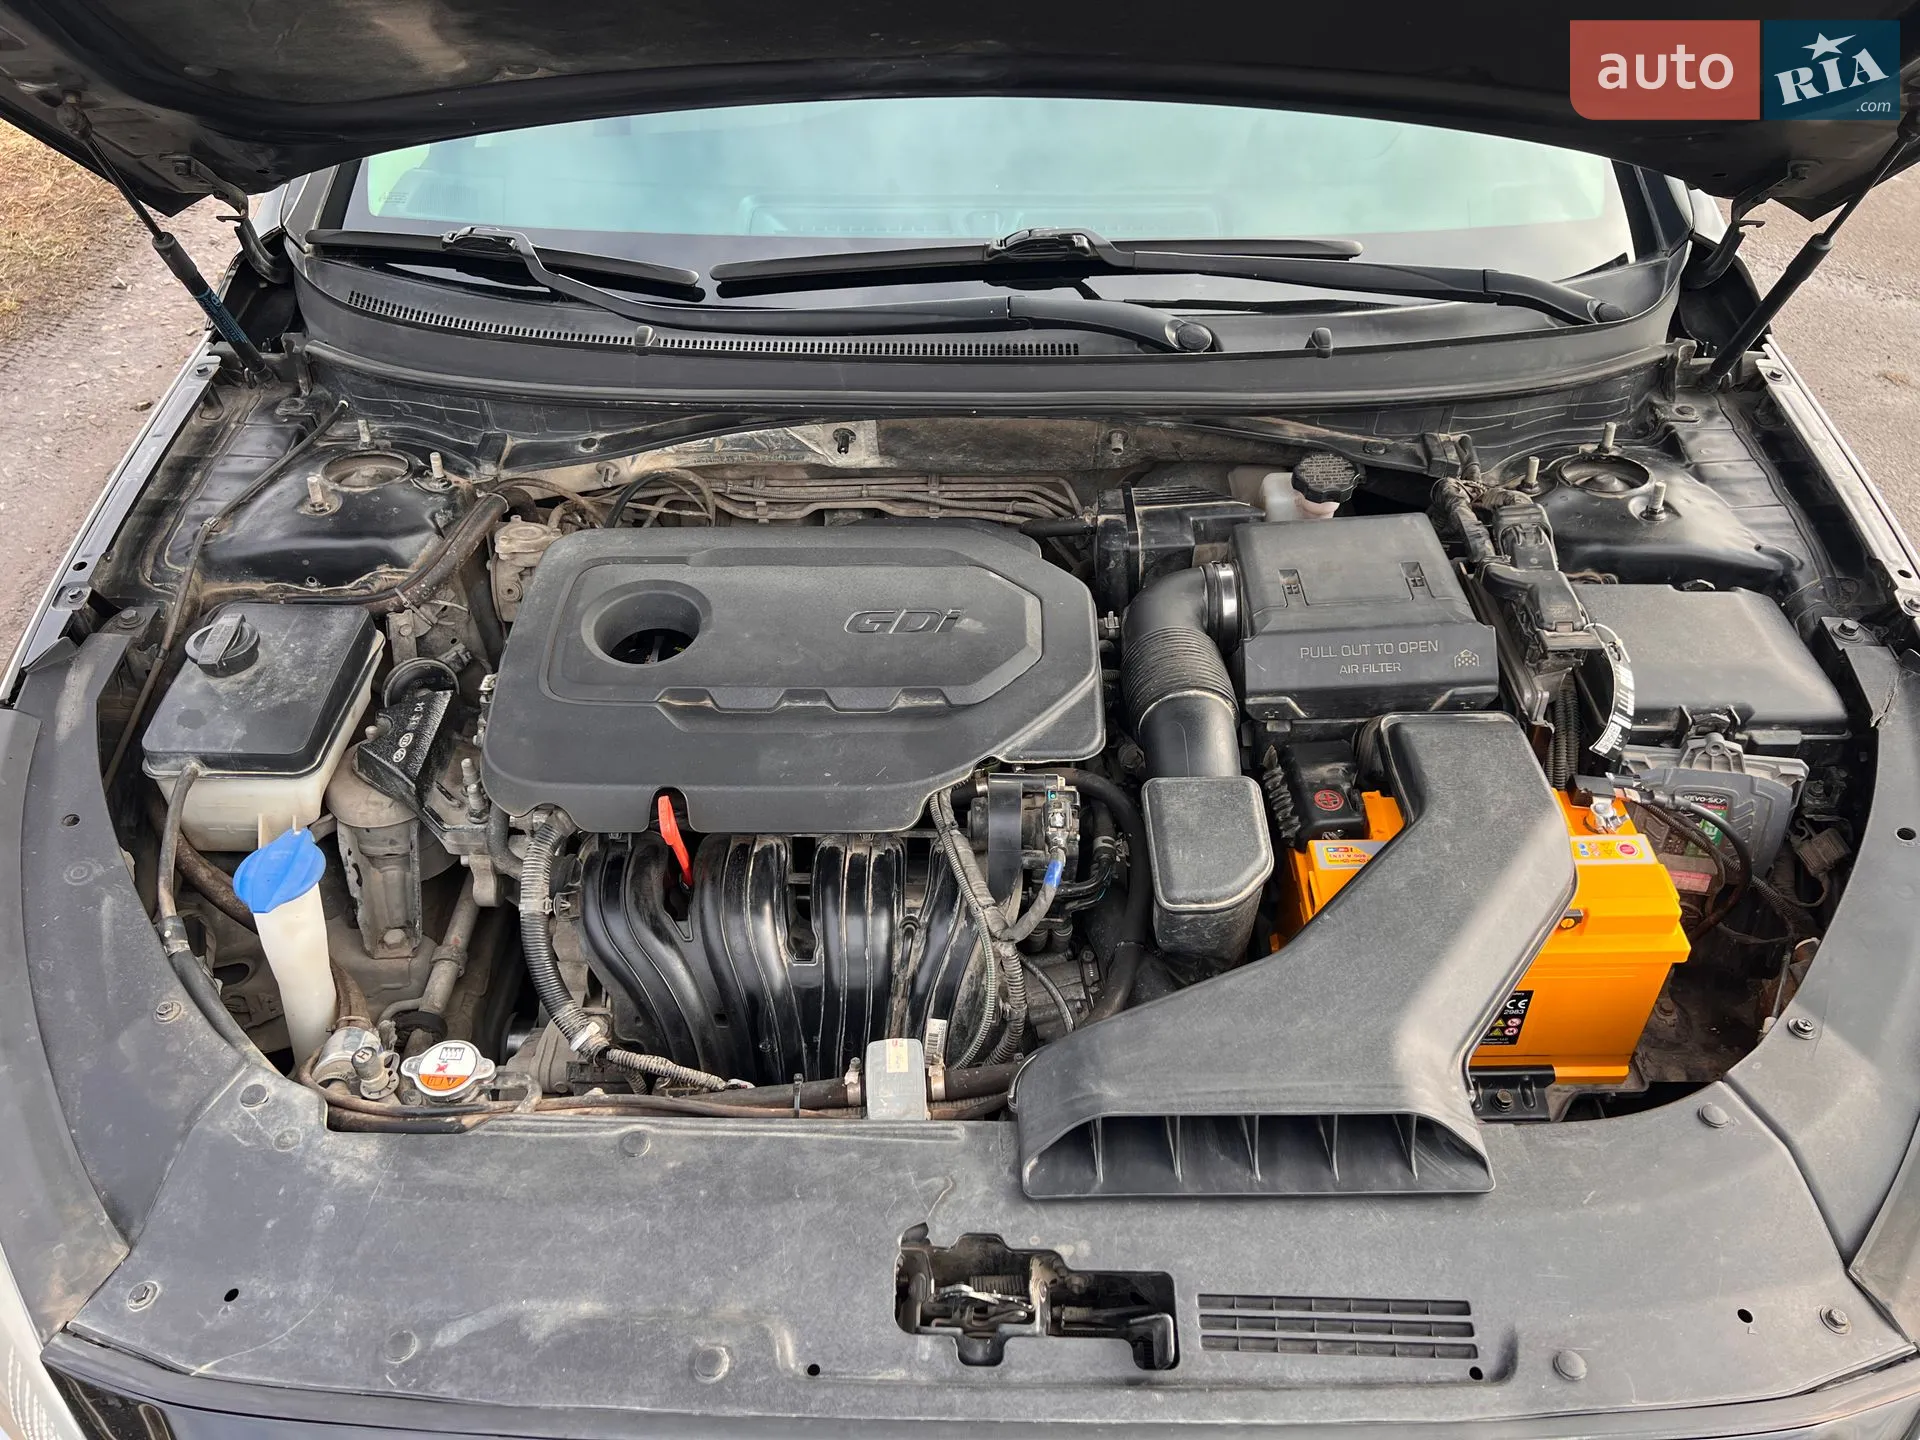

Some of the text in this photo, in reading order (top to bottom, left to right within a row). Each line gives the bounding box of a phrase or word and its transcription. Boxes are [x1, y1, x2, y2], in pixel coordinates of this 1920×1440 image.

[1300, 640, 1439, 658] PULL OUT TO OPEN
[1339, 662, 1402, 674] AIR FILTER
[1506, 999, 1528, 1008] CE
